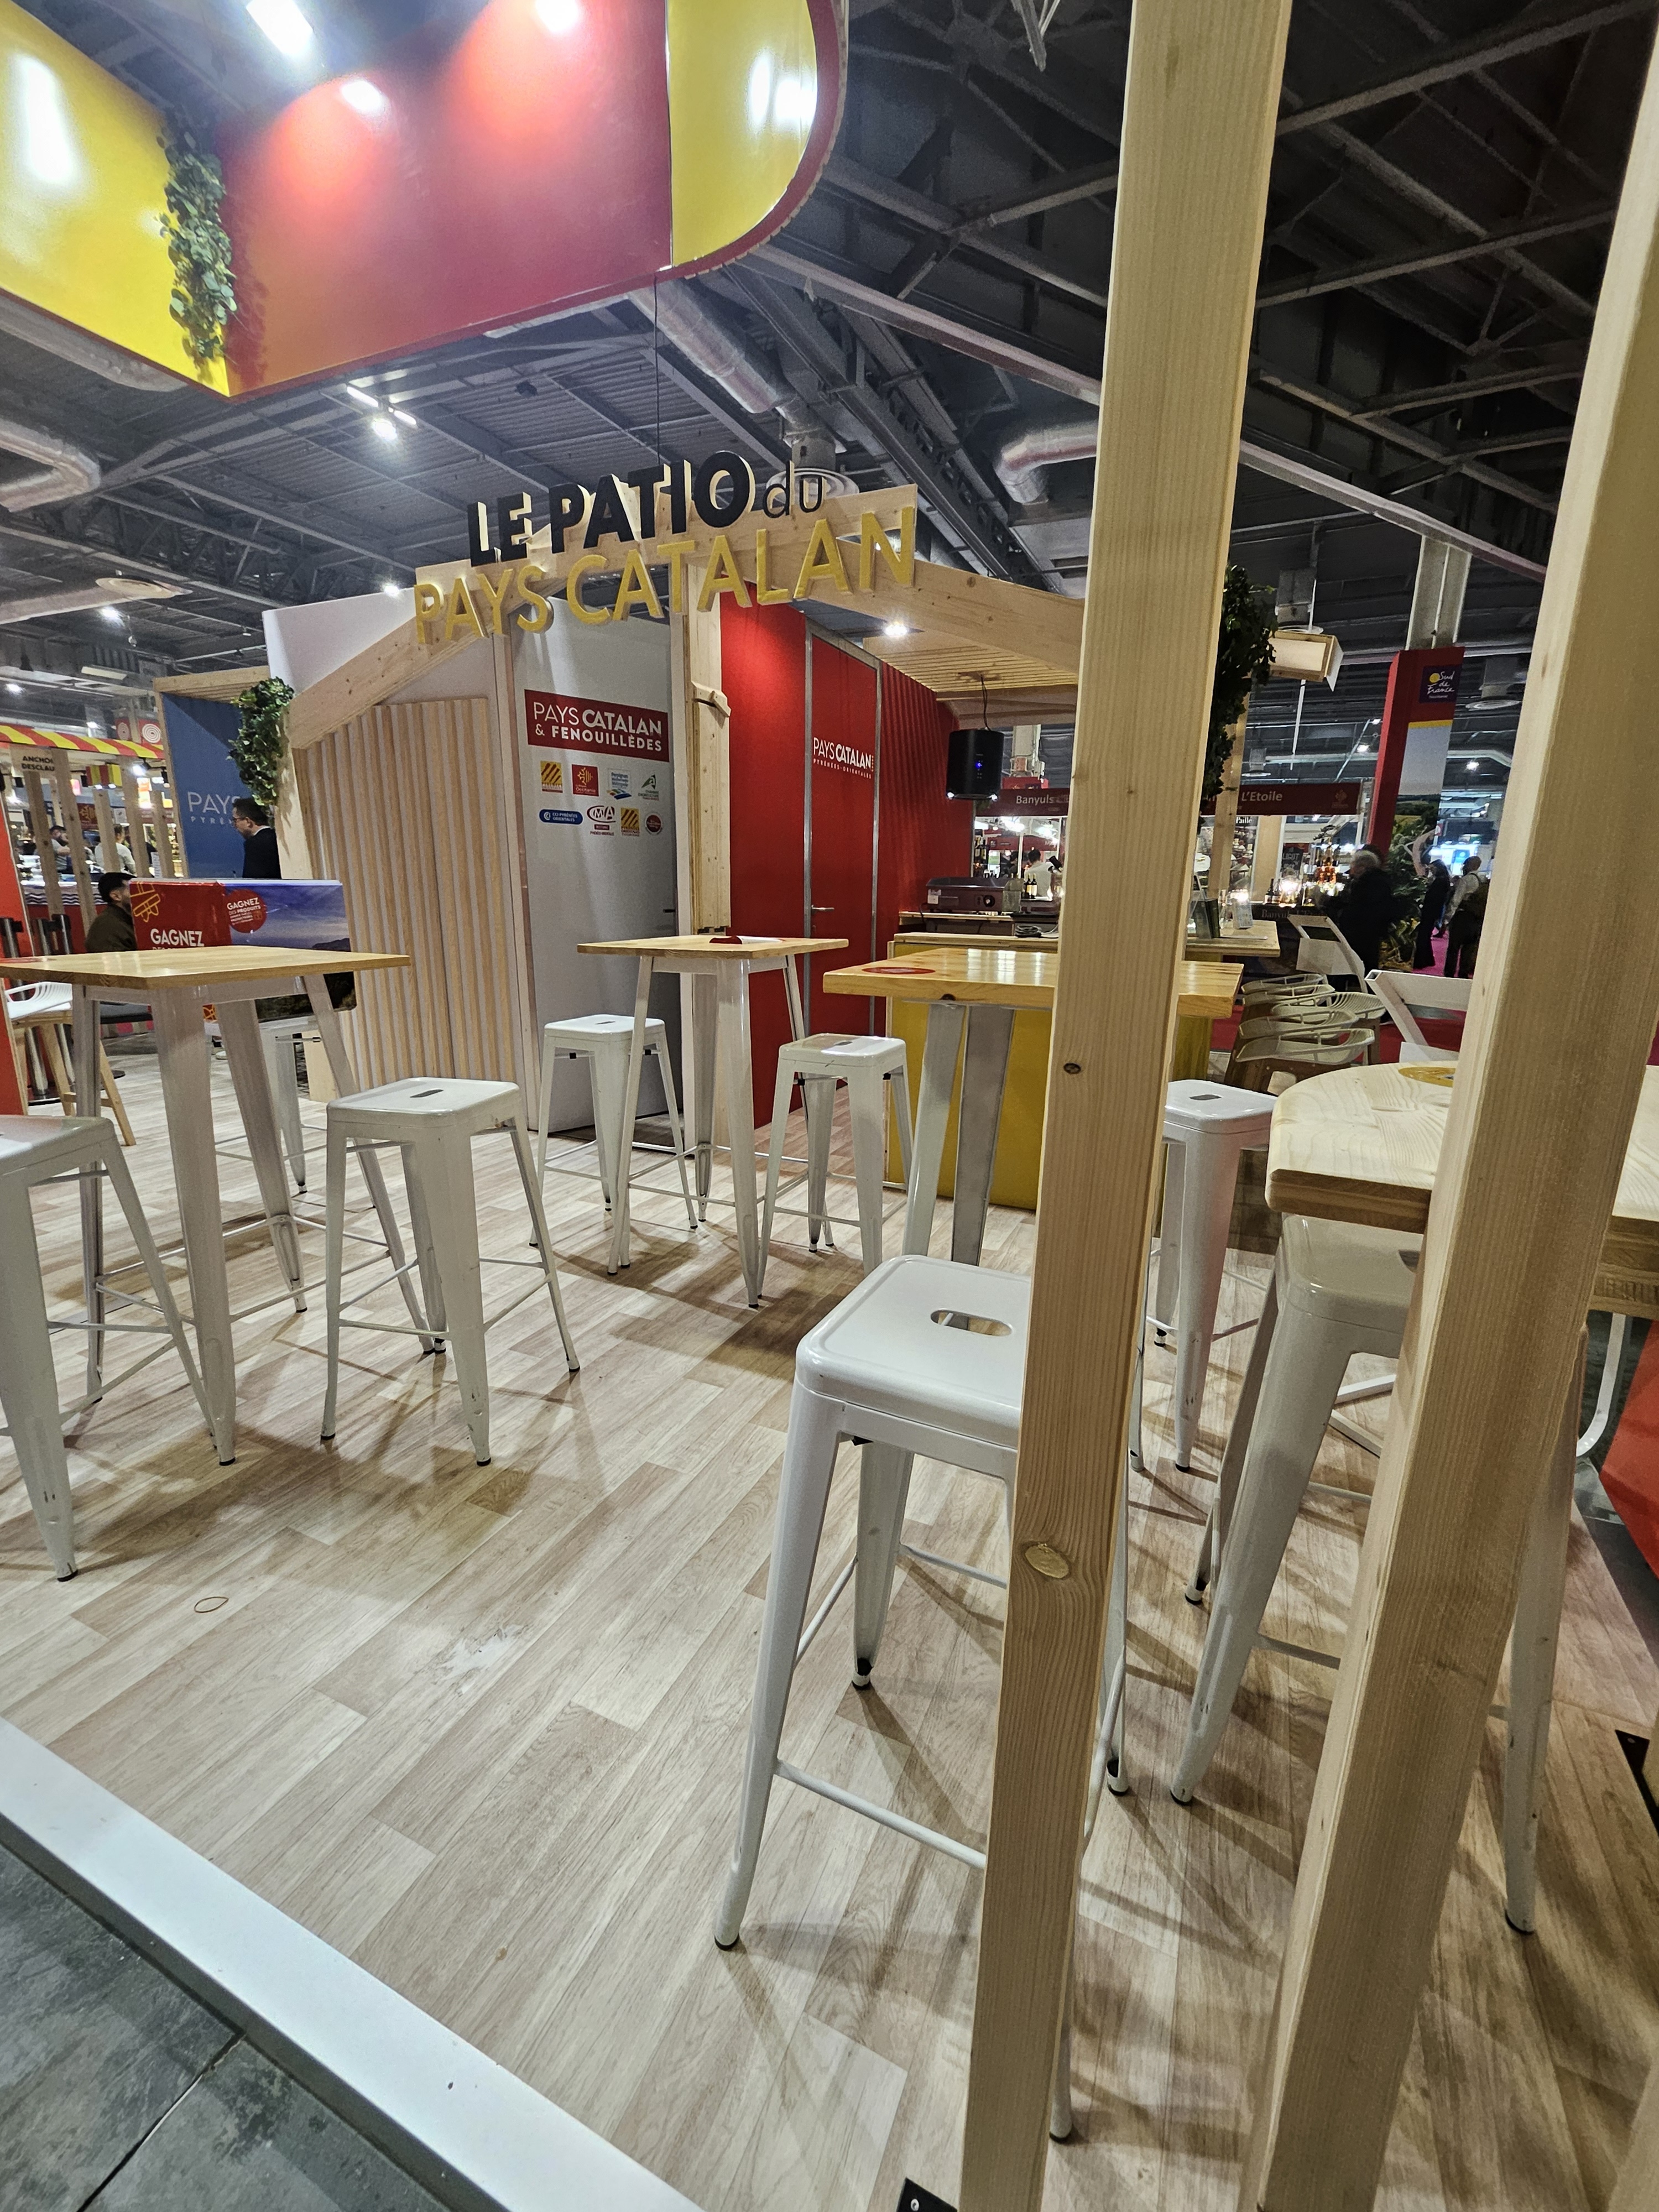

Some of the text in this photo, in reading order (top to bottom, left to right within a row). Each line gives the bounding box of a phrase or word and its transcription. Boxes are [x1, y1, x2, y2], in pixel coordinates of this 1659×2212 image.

[467, 450, 825, 567] LE PATIO du
[414, 504, 916, 646] PAYS CATALAN
[1439, 670, 1455, 681] Sud
[1427, 684, 1455, 695] France
[533, 701, 662, 736] PAYS CATALAN
[535, 723, 662, 752] & FENOUILLÈDES
[813, 737, 872, 769] PAYS CATALAN
[1016, 794, 1054, 806] Banyuls
[1241, 791, 1283, 802] L'Etoile
[227, 897, 260, 910] GAGNEZ
[150, 928, 205, 947] GAGNEZ
